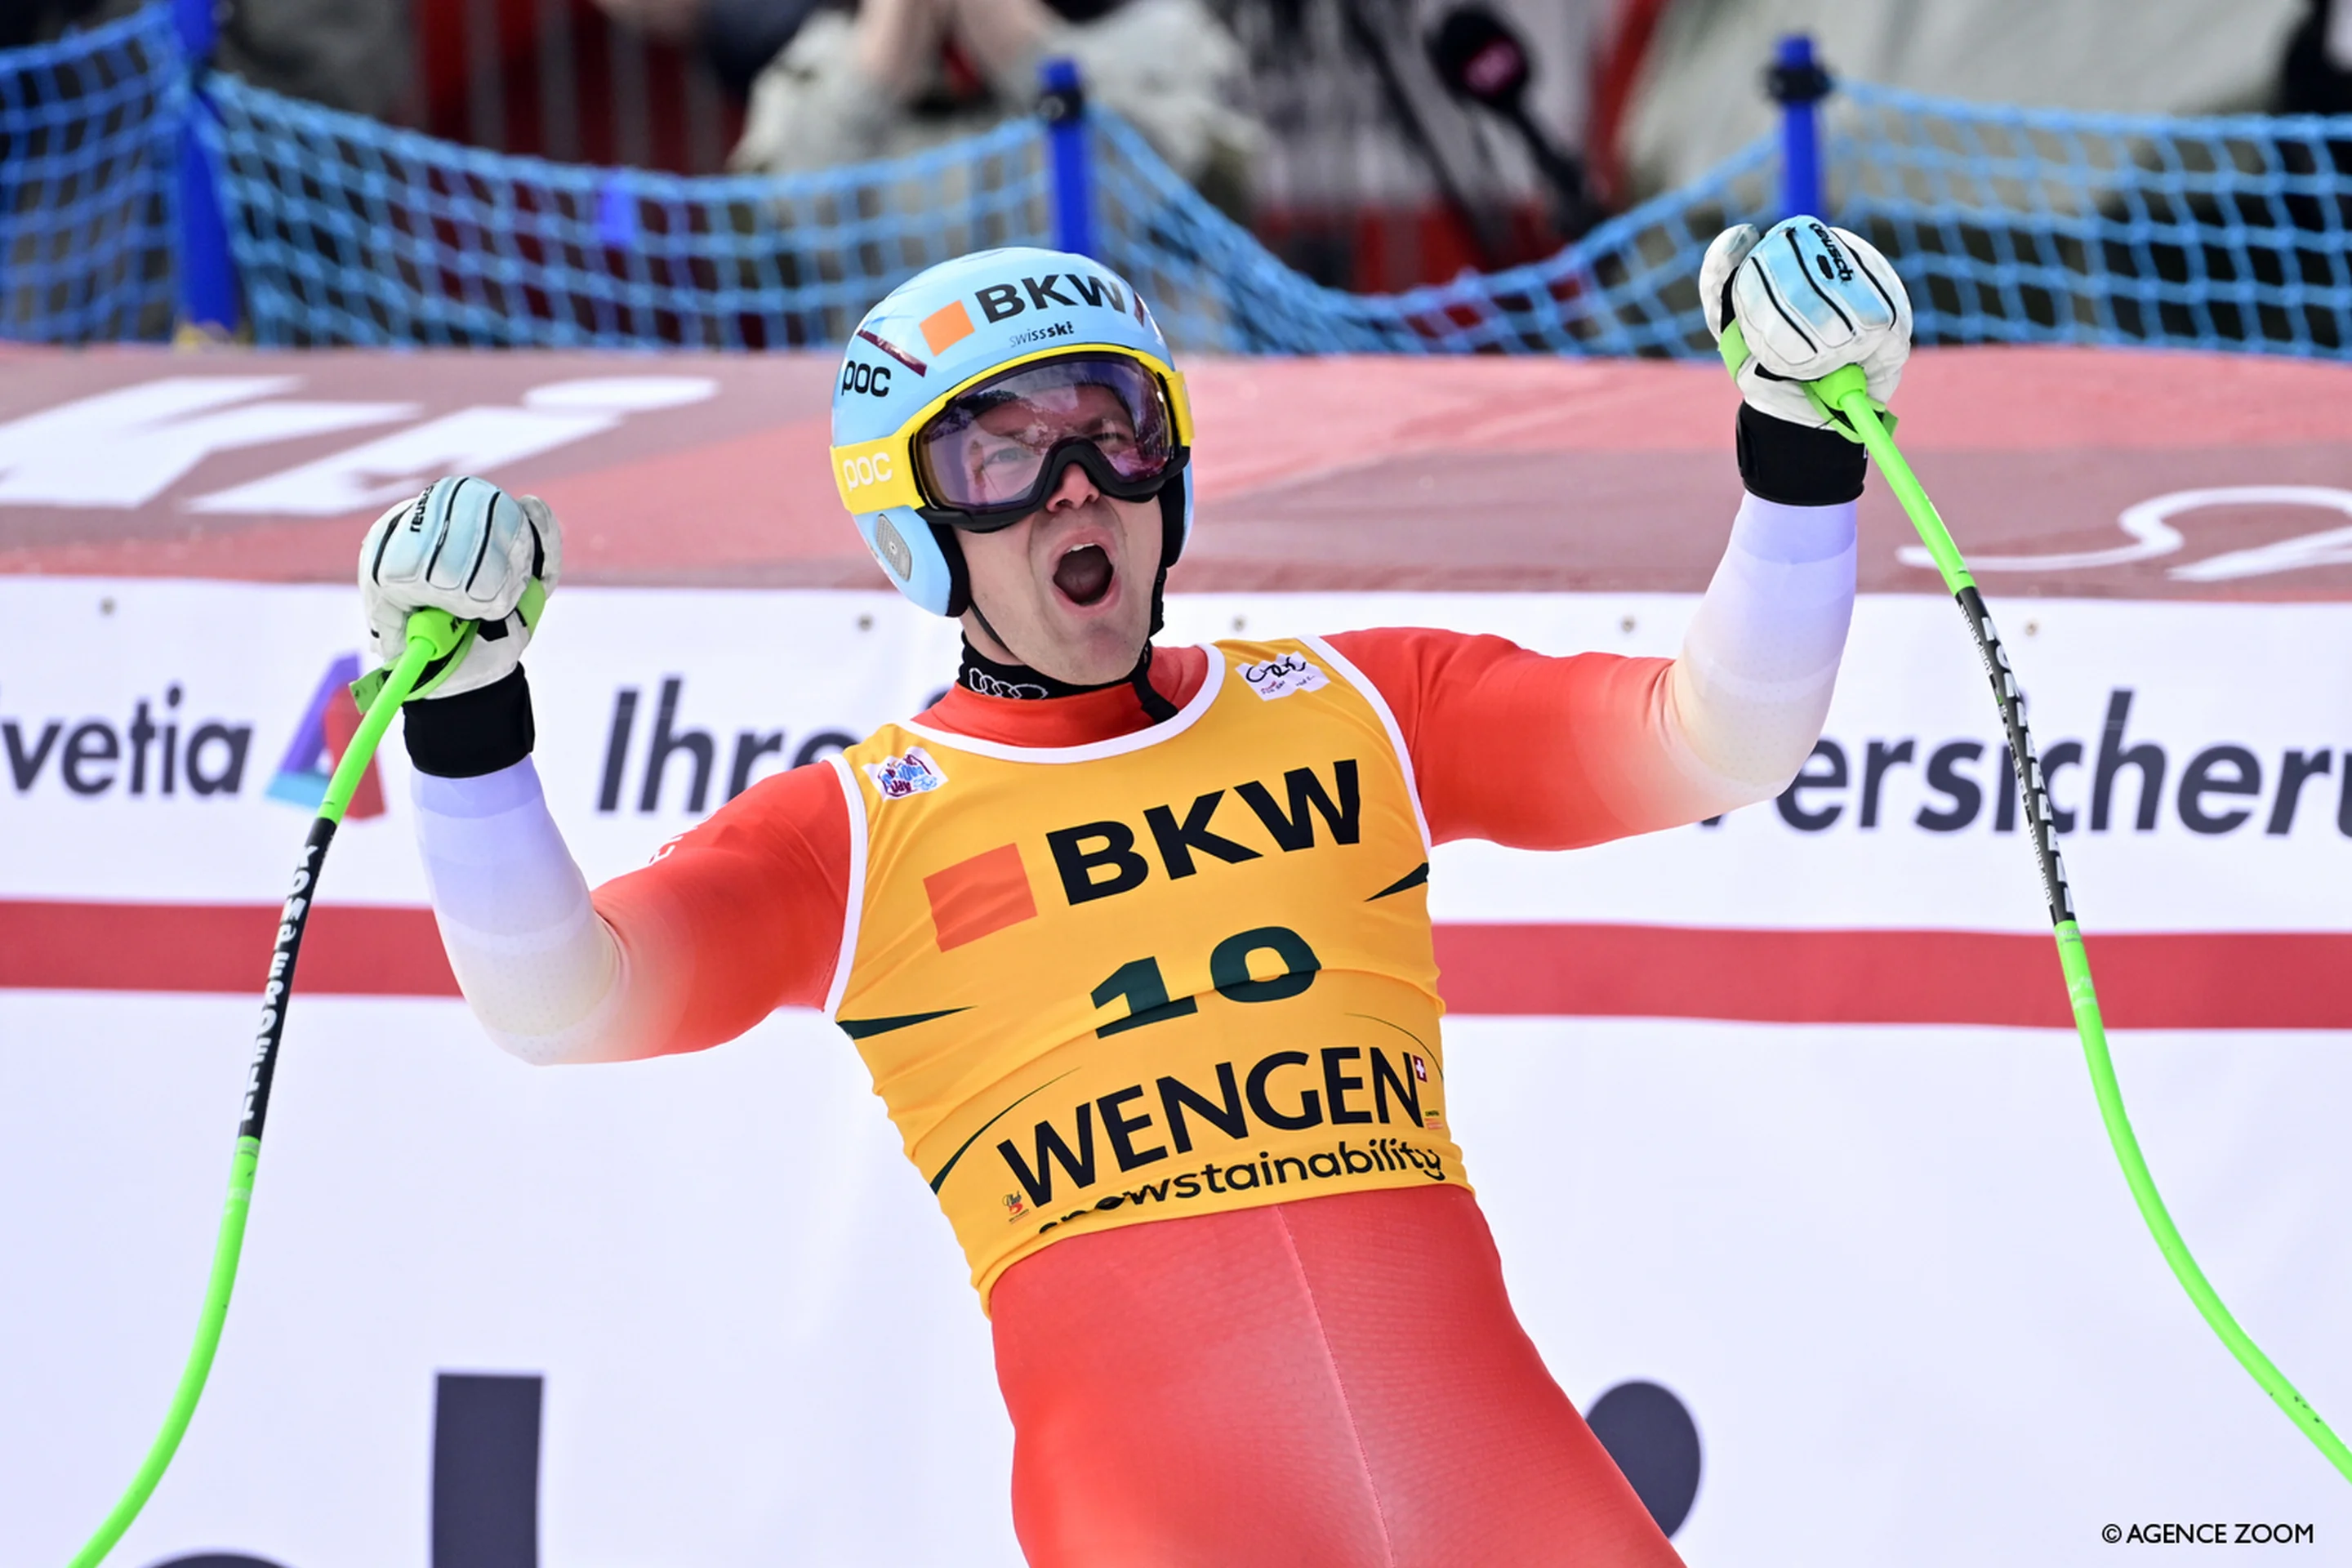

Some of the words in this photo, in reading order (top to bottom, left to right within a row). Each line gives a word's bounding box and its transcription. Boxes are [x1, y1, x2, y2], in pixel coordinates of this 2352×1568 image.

[974, 274, 1127, 324] BKW
[1046, 759, 1361, 906] BKW
[1701, 688, 2352, 837] ersicher
[1089, 925, 1322, 1039] 10
[996, 1046, 1425, 1209] WENGEN
